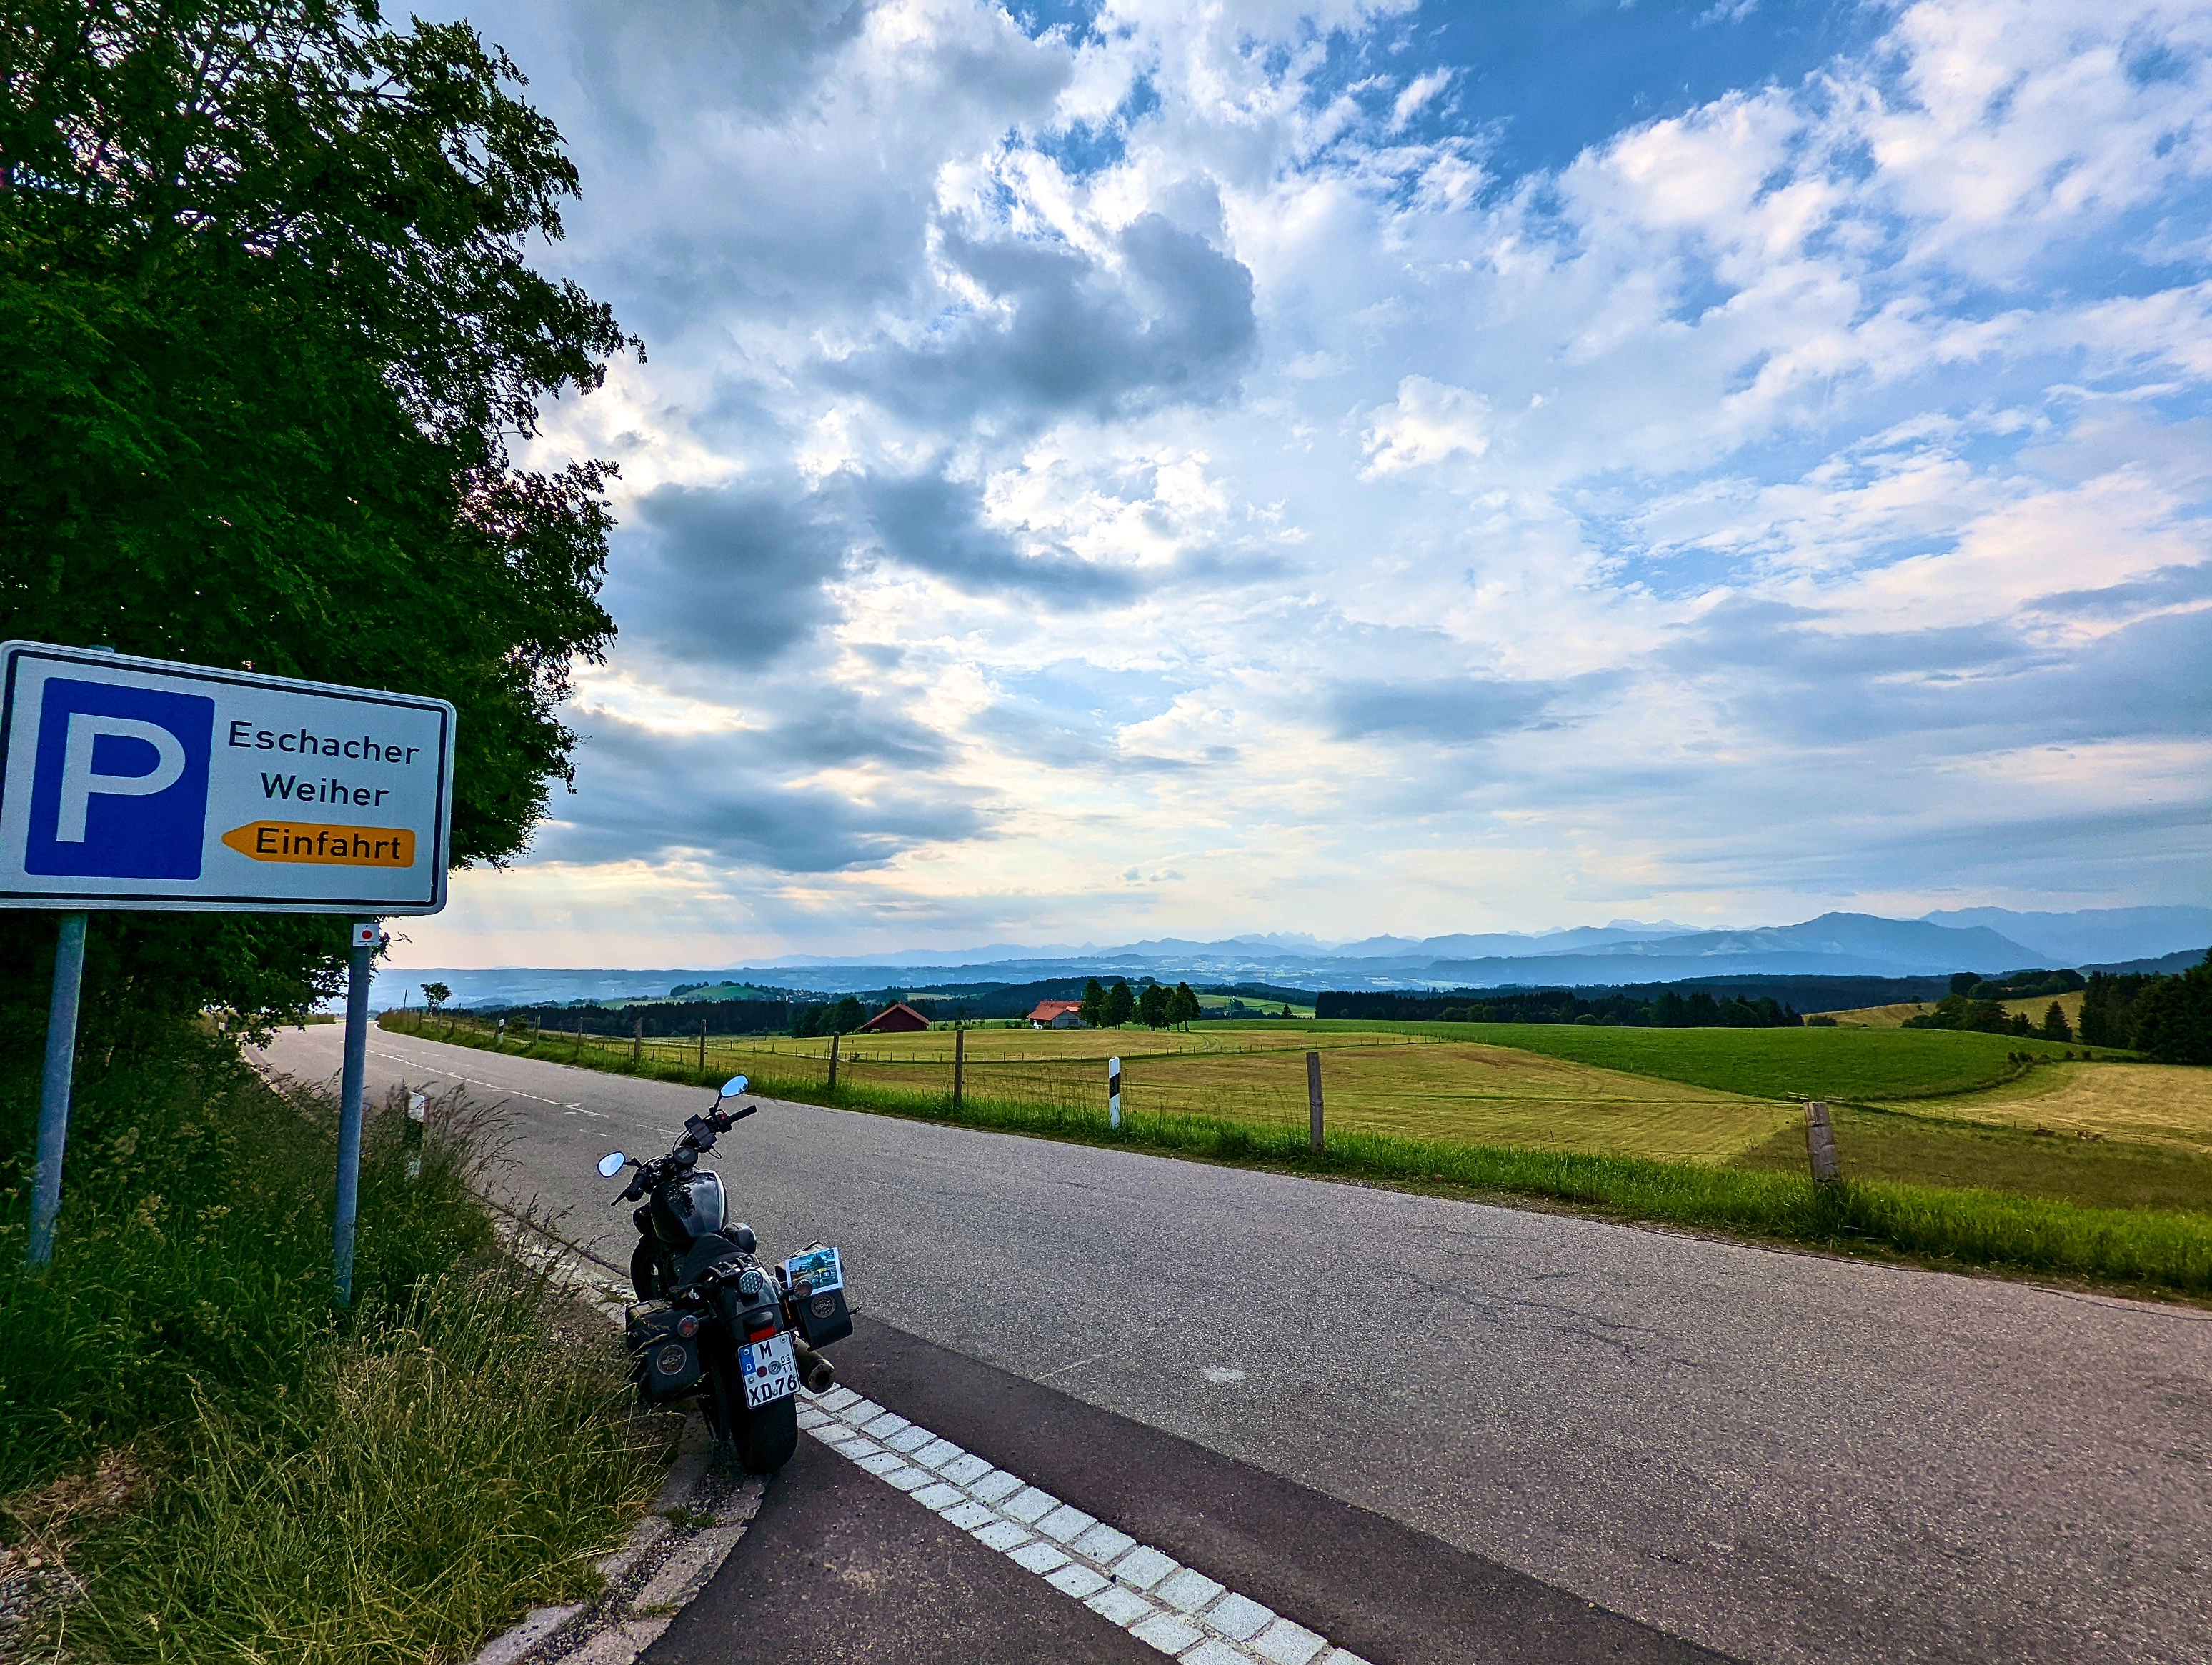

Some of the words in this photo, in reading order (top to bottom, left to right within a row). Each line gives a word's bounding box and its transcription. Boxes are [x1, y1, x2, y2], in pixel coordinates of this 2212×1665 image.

[229, 721, 420, 764] Eschacher
[56, 712, 186, 843] P
[261, 772, 389, 807] Weiher
[256, 826, 402, 860] Einfahrt
[759, 1341, 772, 1359] M
[781, 1354, 791, 1363] 03
